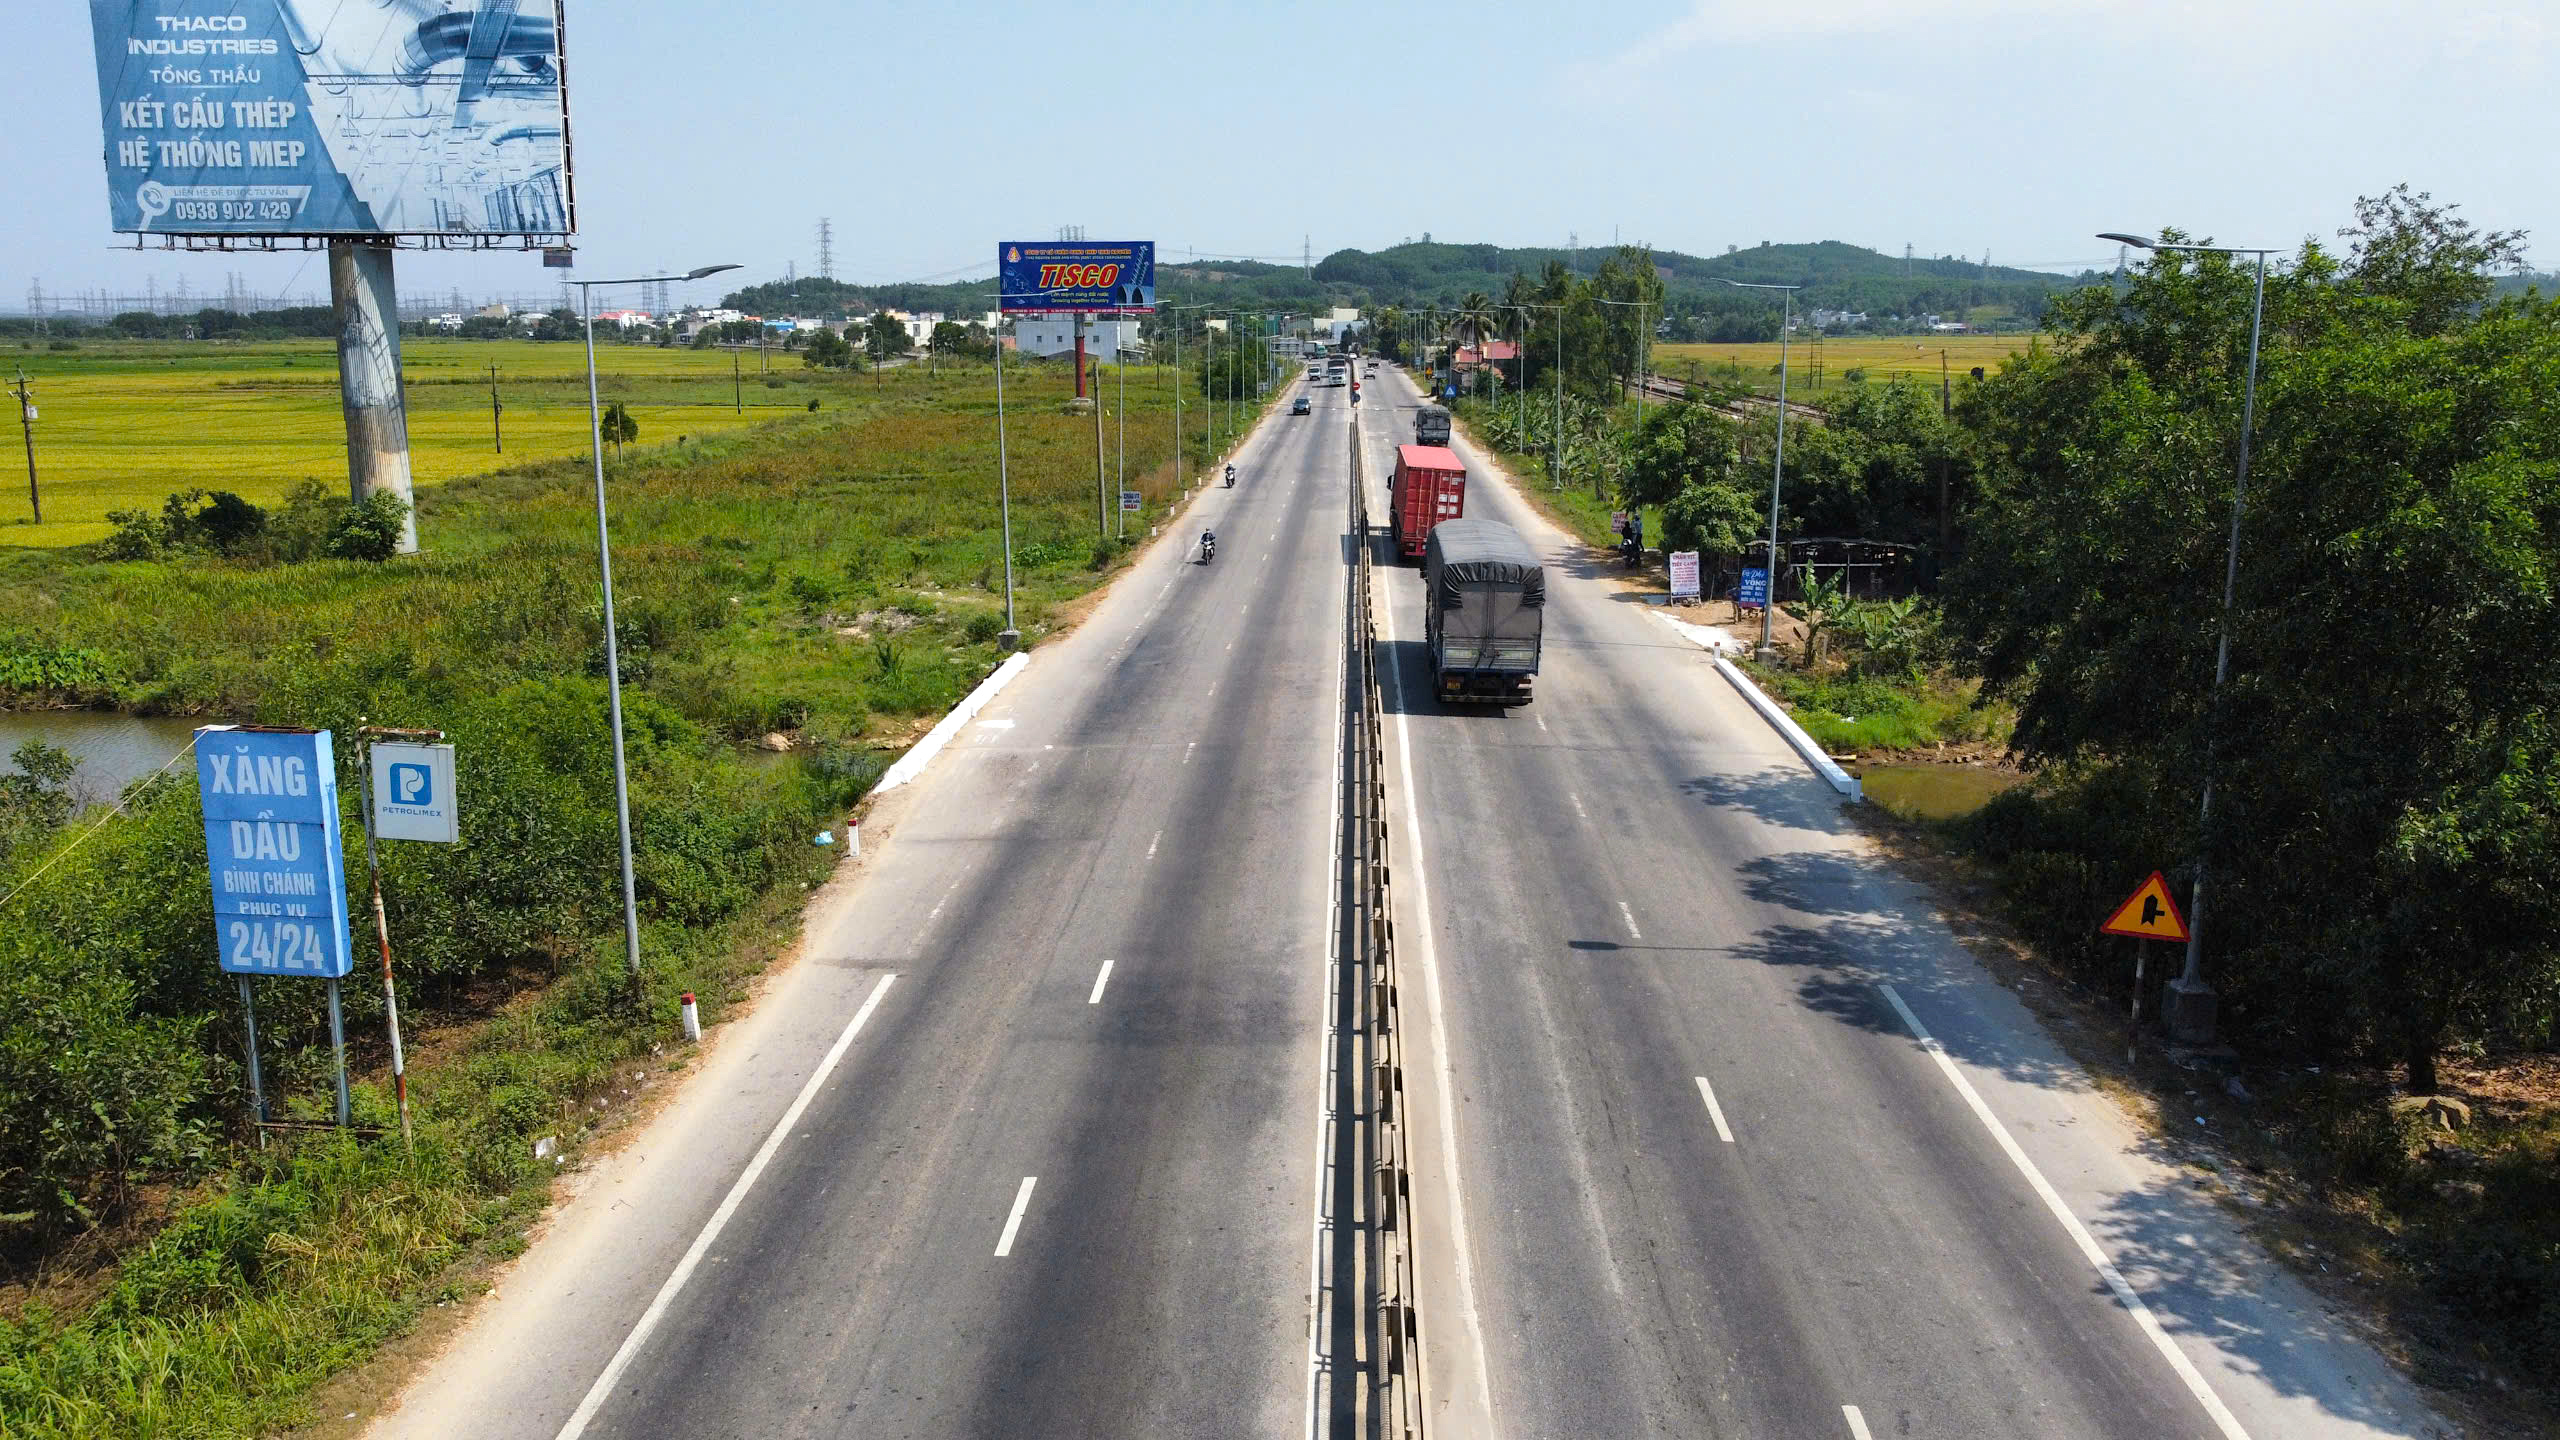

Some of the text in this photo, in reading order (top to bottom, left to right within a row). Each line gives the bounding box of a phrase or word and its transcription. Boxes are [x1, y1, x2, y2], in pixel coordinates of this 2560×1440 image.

[155, 15, 247, 32] THACO
[127, 38, 279, 56] INDUSTRIES
[149, 63, 261, 85] TỔNG THẦU
[119, 92, 296, 129] KẾT CẤU THÉP
[119, 131, 306, 174] HỆ THỐNG MEP
[175, 201, 292, 220] 0938 902 429
[1039, 264, 1119, 289] TISCO
[208, 745, 308, 797] XĂNG
[382, 806, 442, 818] PETROLIMEX
[230, 809, 301, 862] DẦU
[223, 865, 317, 896] BÌNH CHÁNH
[230, 921, 324, 970] 24/24
